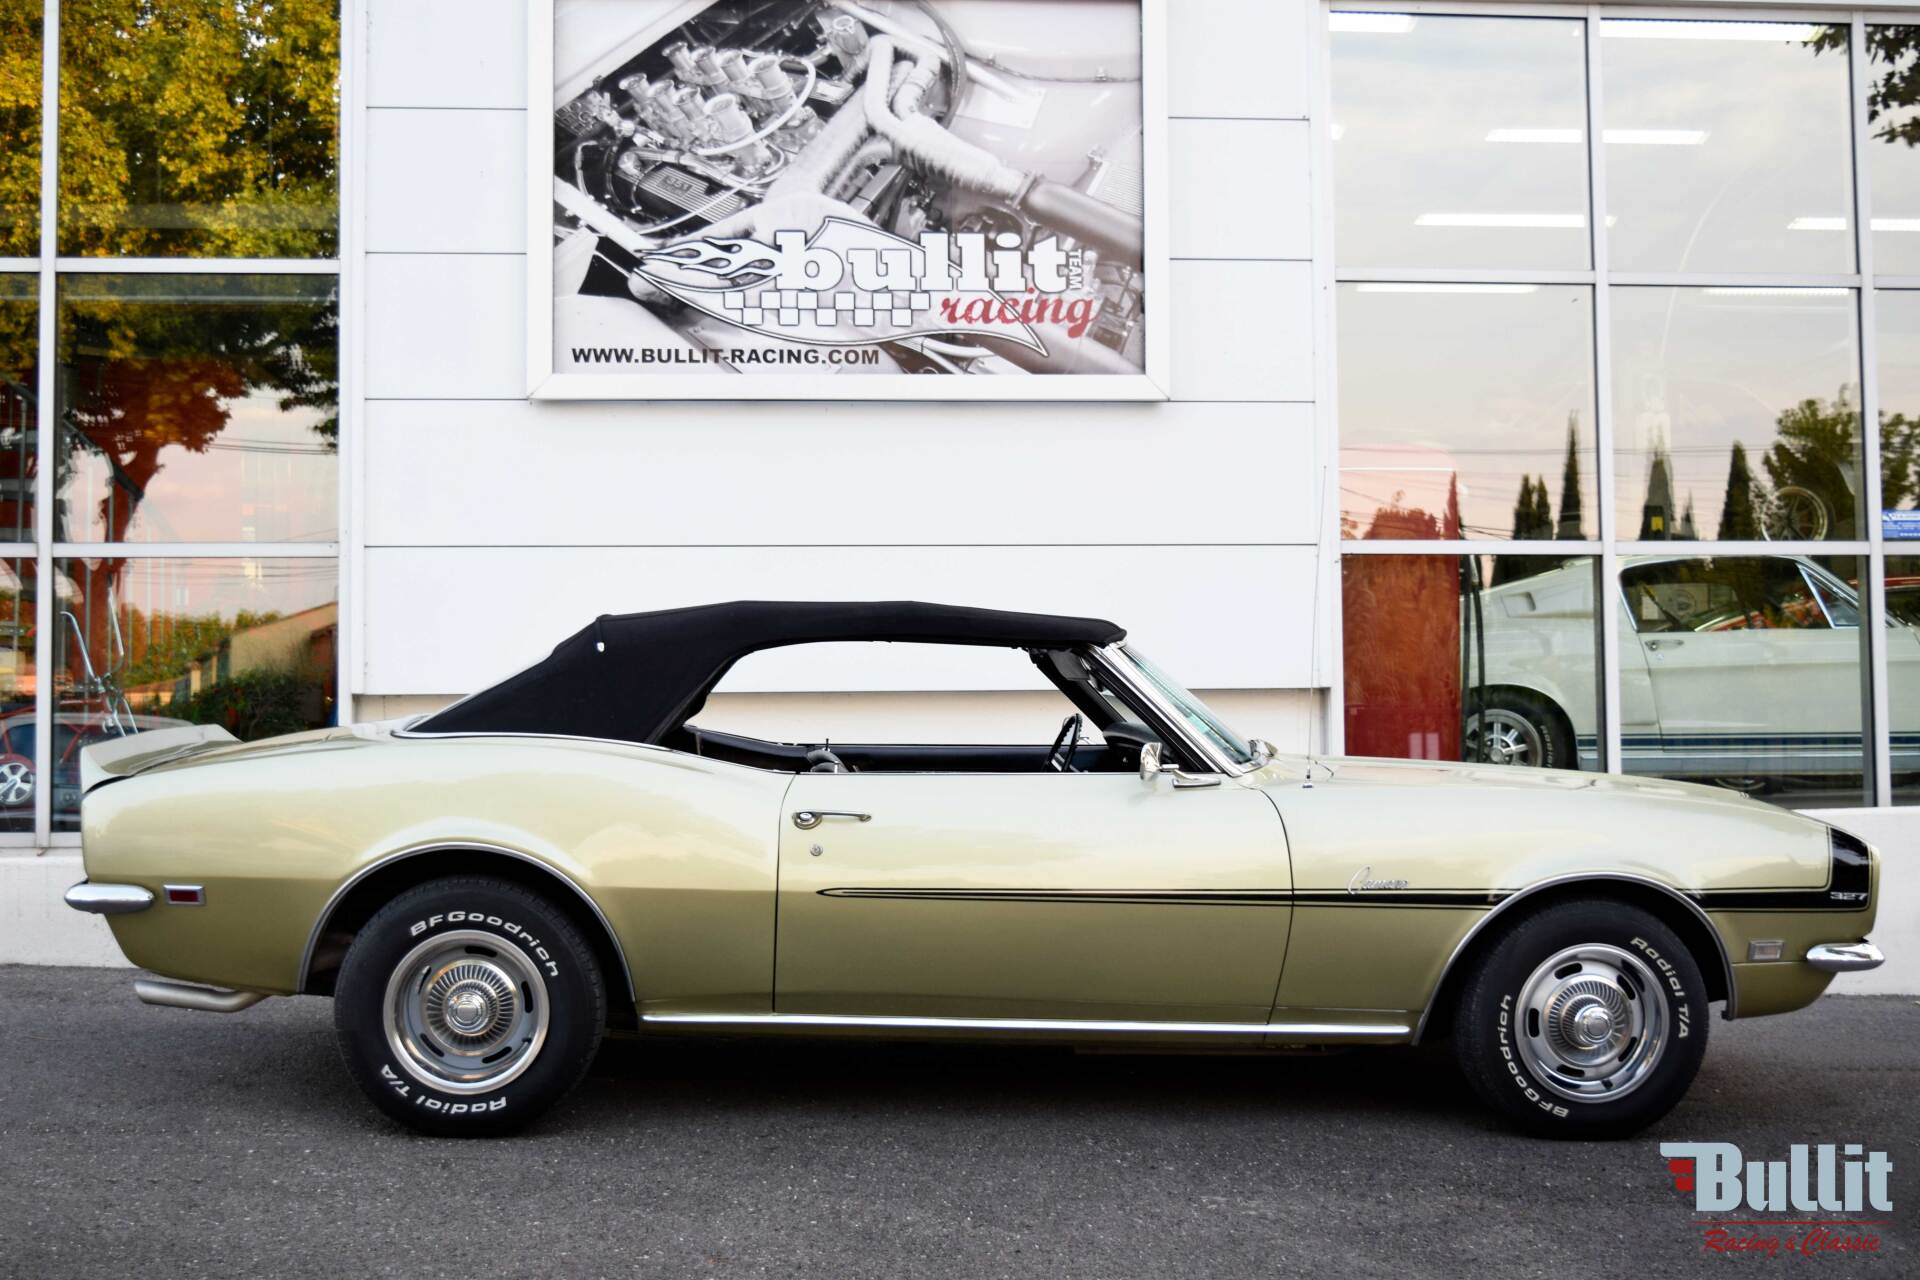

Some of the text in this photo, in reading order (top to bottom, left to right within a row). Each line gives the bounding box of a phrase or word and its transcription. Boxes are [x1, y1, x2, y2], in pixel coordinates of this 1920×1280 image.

[775, 229, 1068, 294] bullit
[1069, 248, 1083, 291] TEAM
[940, 287, 1102, 339] racing
[571, 347, 880, 365] WWW.BULLIT-RACING.COM
[1829, 891, 1868, 901] 327
[409, 910, 560, 978] BFGoodrich
[1629, 936, 1691, 1040] Radial T/A
[1497, 994, 1571, 1119] BFGoodrich
[380, 1063, 508, 1115] Radial T/A
